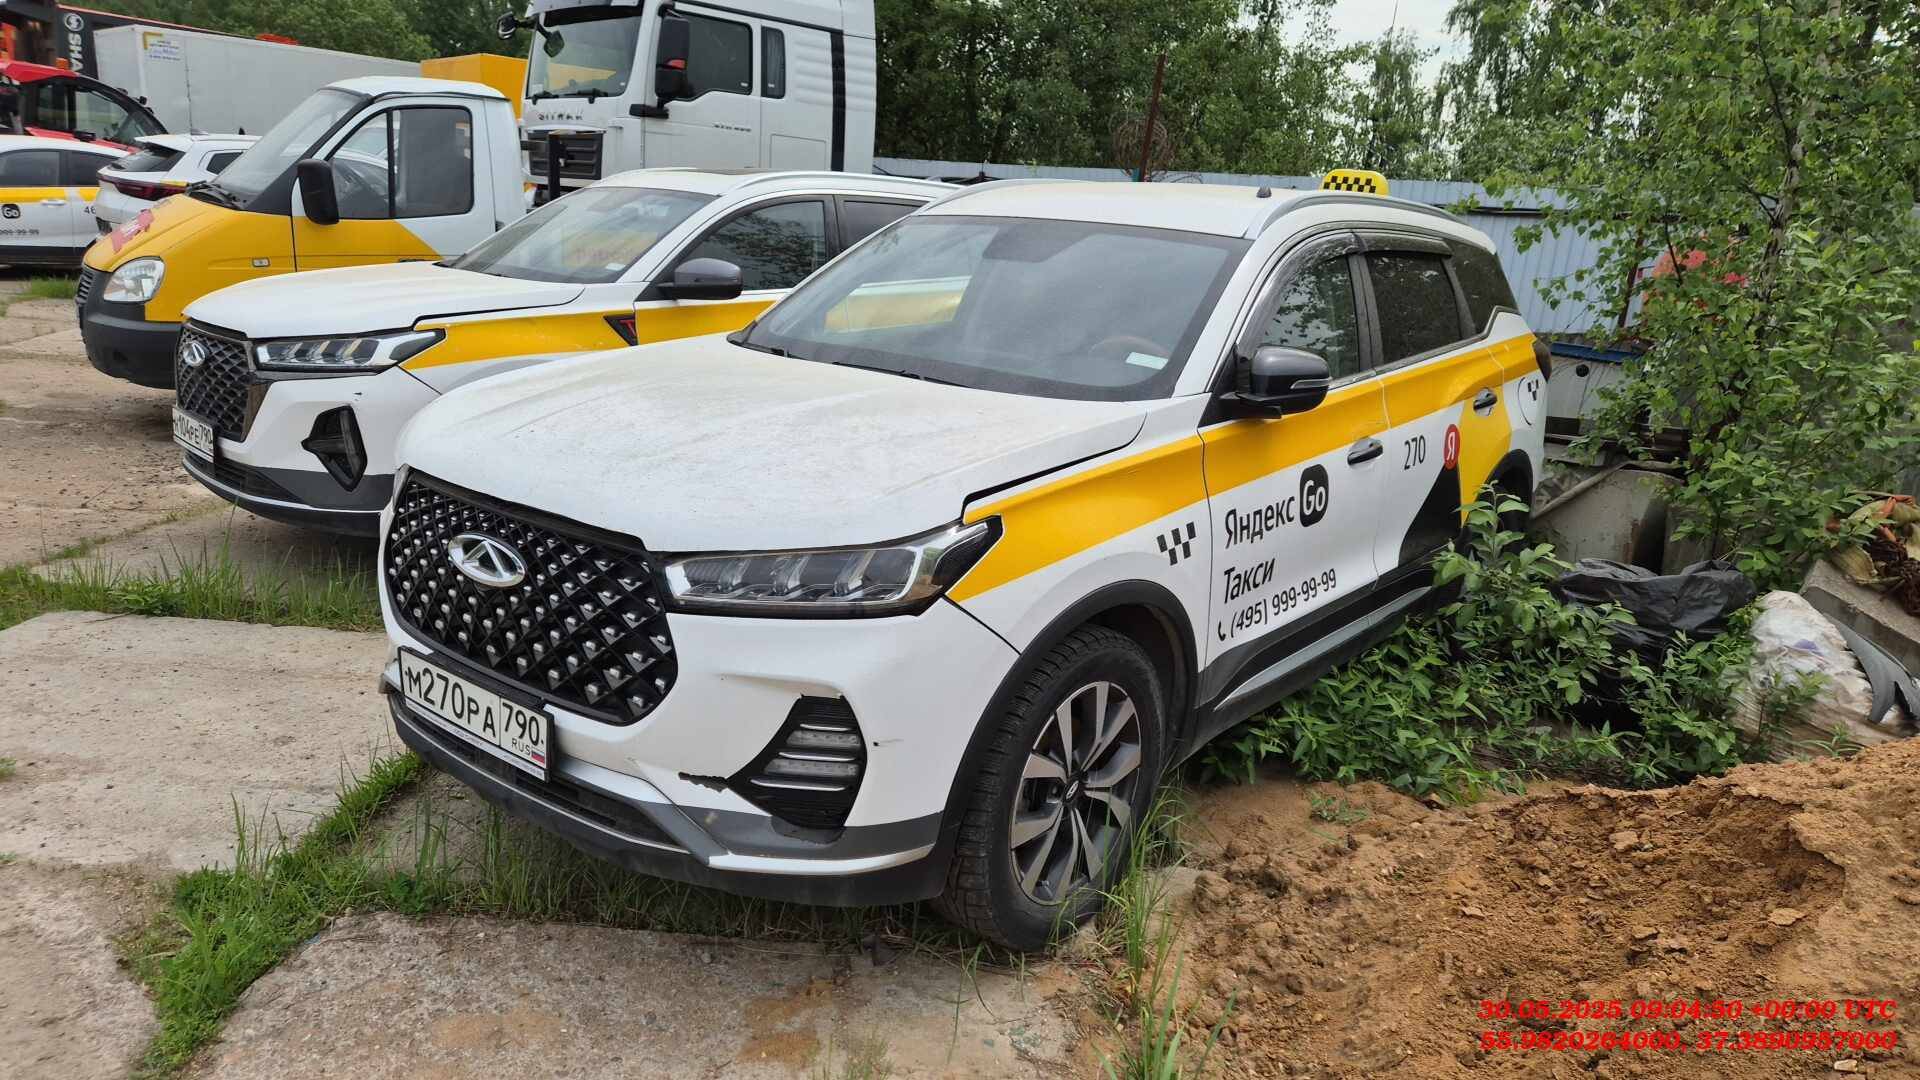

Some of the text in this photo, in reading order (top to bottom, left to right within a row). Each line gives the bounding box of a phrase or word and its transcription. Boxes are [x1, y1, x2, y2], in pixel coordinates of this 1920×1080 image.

[1404, 434, 1426, 471] 270
[1224, 479, 1326, 549] Яндекс Go
[1223, 557, 1276, 604] Такси
[1230, 567, 1337, 638] (495) 999-99-99
[511, 737, 531, 756] RUS
